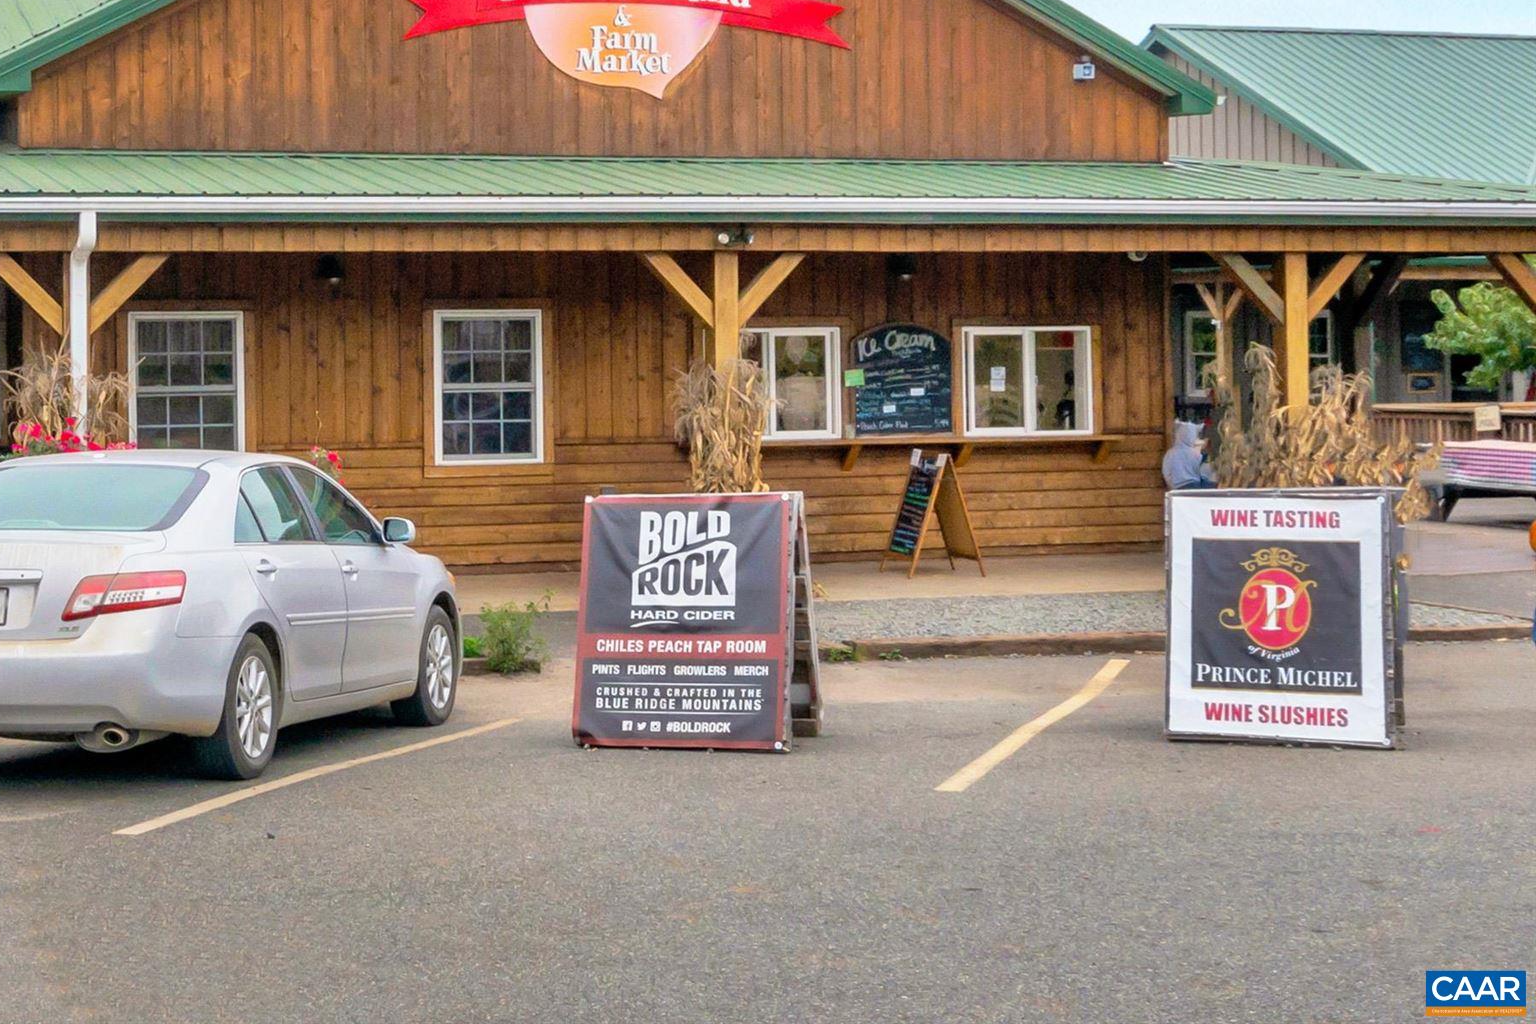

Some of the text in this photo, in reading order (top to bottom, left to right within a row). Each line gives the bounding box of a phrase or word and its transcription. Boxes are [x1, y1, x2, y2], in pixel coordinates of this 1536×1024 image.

[613, 5, 632, 27] &
[590, 25, 658, 53] Farm
[576, 47, 672, 75] Market
[884, 330, 936, 352] Cream
[1210, 509, 1340, 528] WINE TASTING
[638, 510, 731, 565] BOLD
[638, 549, 730, 596] ROCK
[630, 609, 736, 621] HARD CIDER
[596, 639, 767, 654] CHILES PEACH TAP ROOM
[1247, 645, 1301, 662] of Virginia
[592, 664, 769, 676] PINTS FLIGHTS GROWLERS MERCH
[1195, 663, 1358, 688] PRINCE MICHEL
[596, 687, 763, 698] CRUSHED & CRAFTED IN THE
[595, 697, 763, 711] BLUE RIDGE MOUNTAINS
[1204, 702, 1348, 727] WINE SLUSHIES
[666, 721, 731, 733] #BOLDROCK
